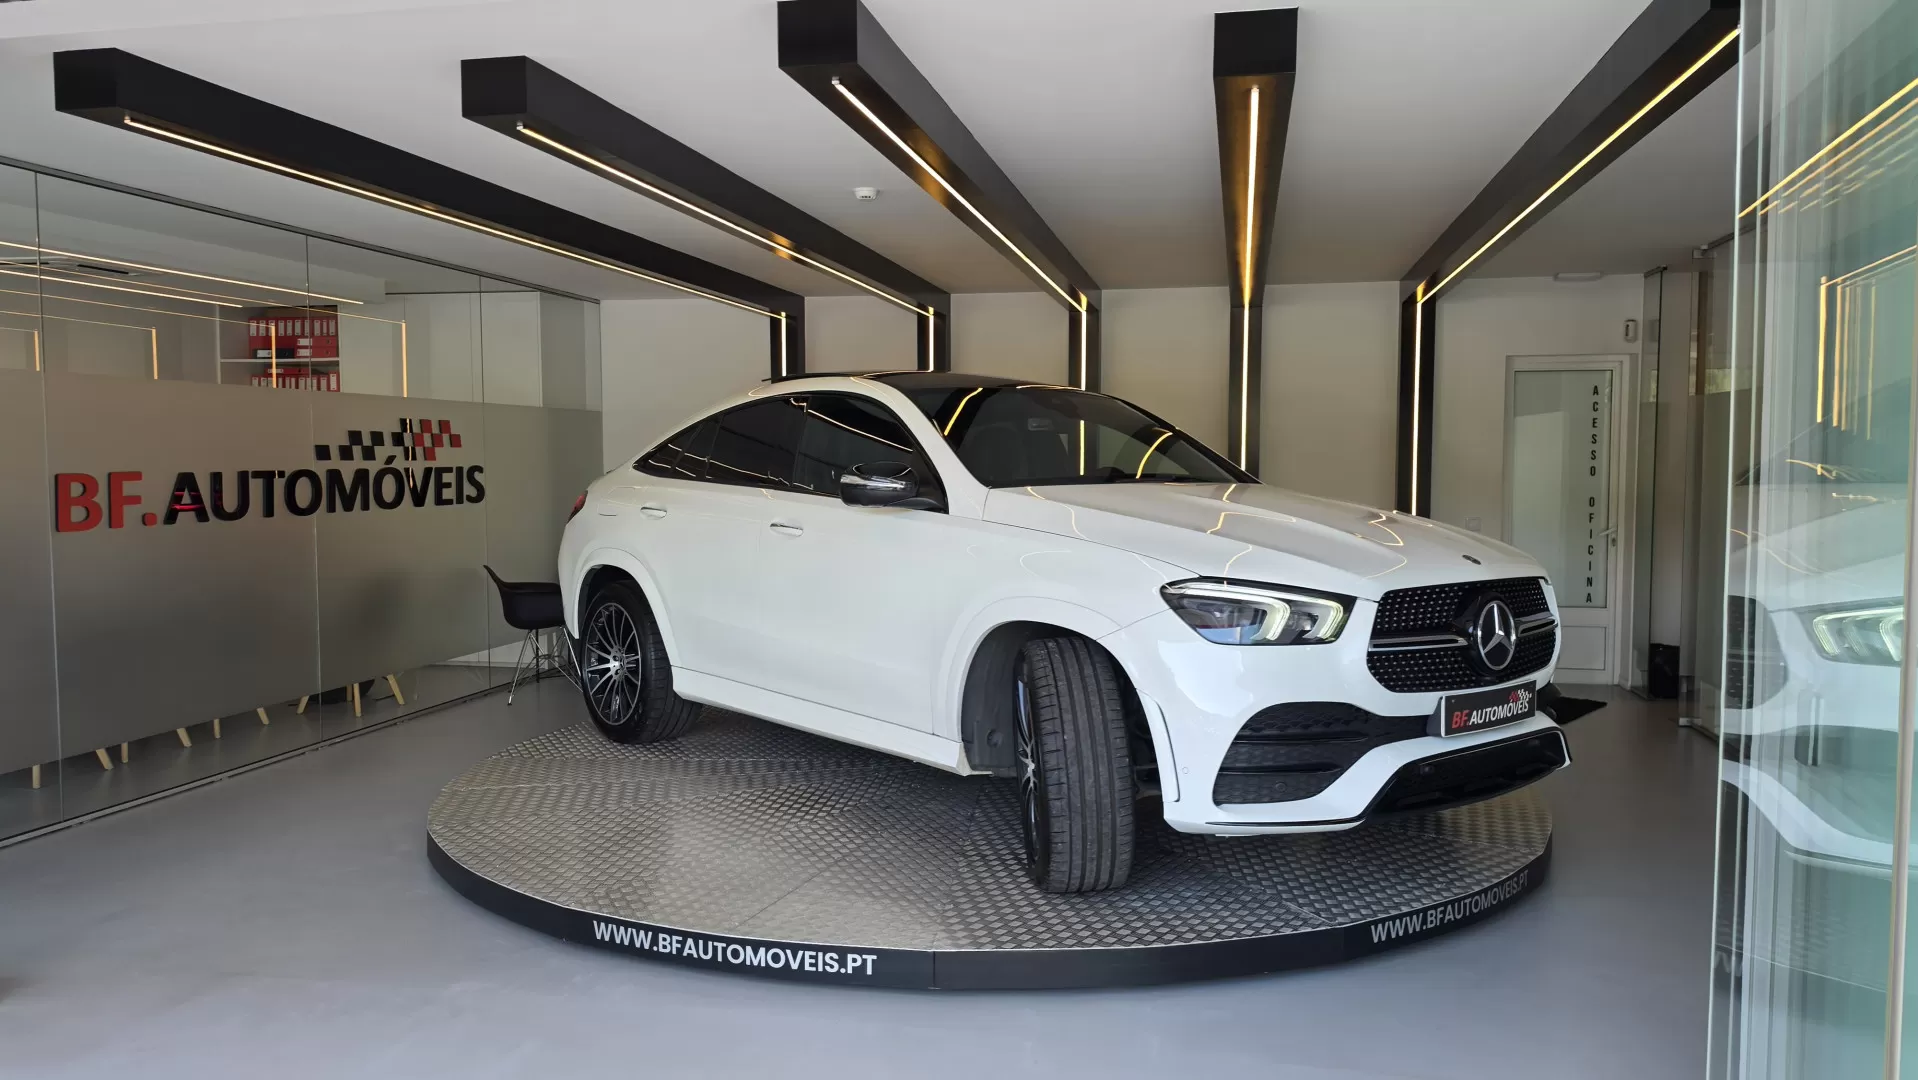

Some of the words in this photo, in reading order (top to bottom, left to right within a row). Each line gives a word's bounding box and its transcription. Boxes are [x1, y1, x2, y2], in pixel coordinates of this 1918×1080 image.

[1589, 385, 1599, 477] ACESSO
[1586, 497, 1595, 603] OFICINA
[593, 920, 877, 975] WWW.BFAUTOMOVEIS.PT
[1371, 870, 1529, 943] WWW.BFAUTOMOVEIS.PT
